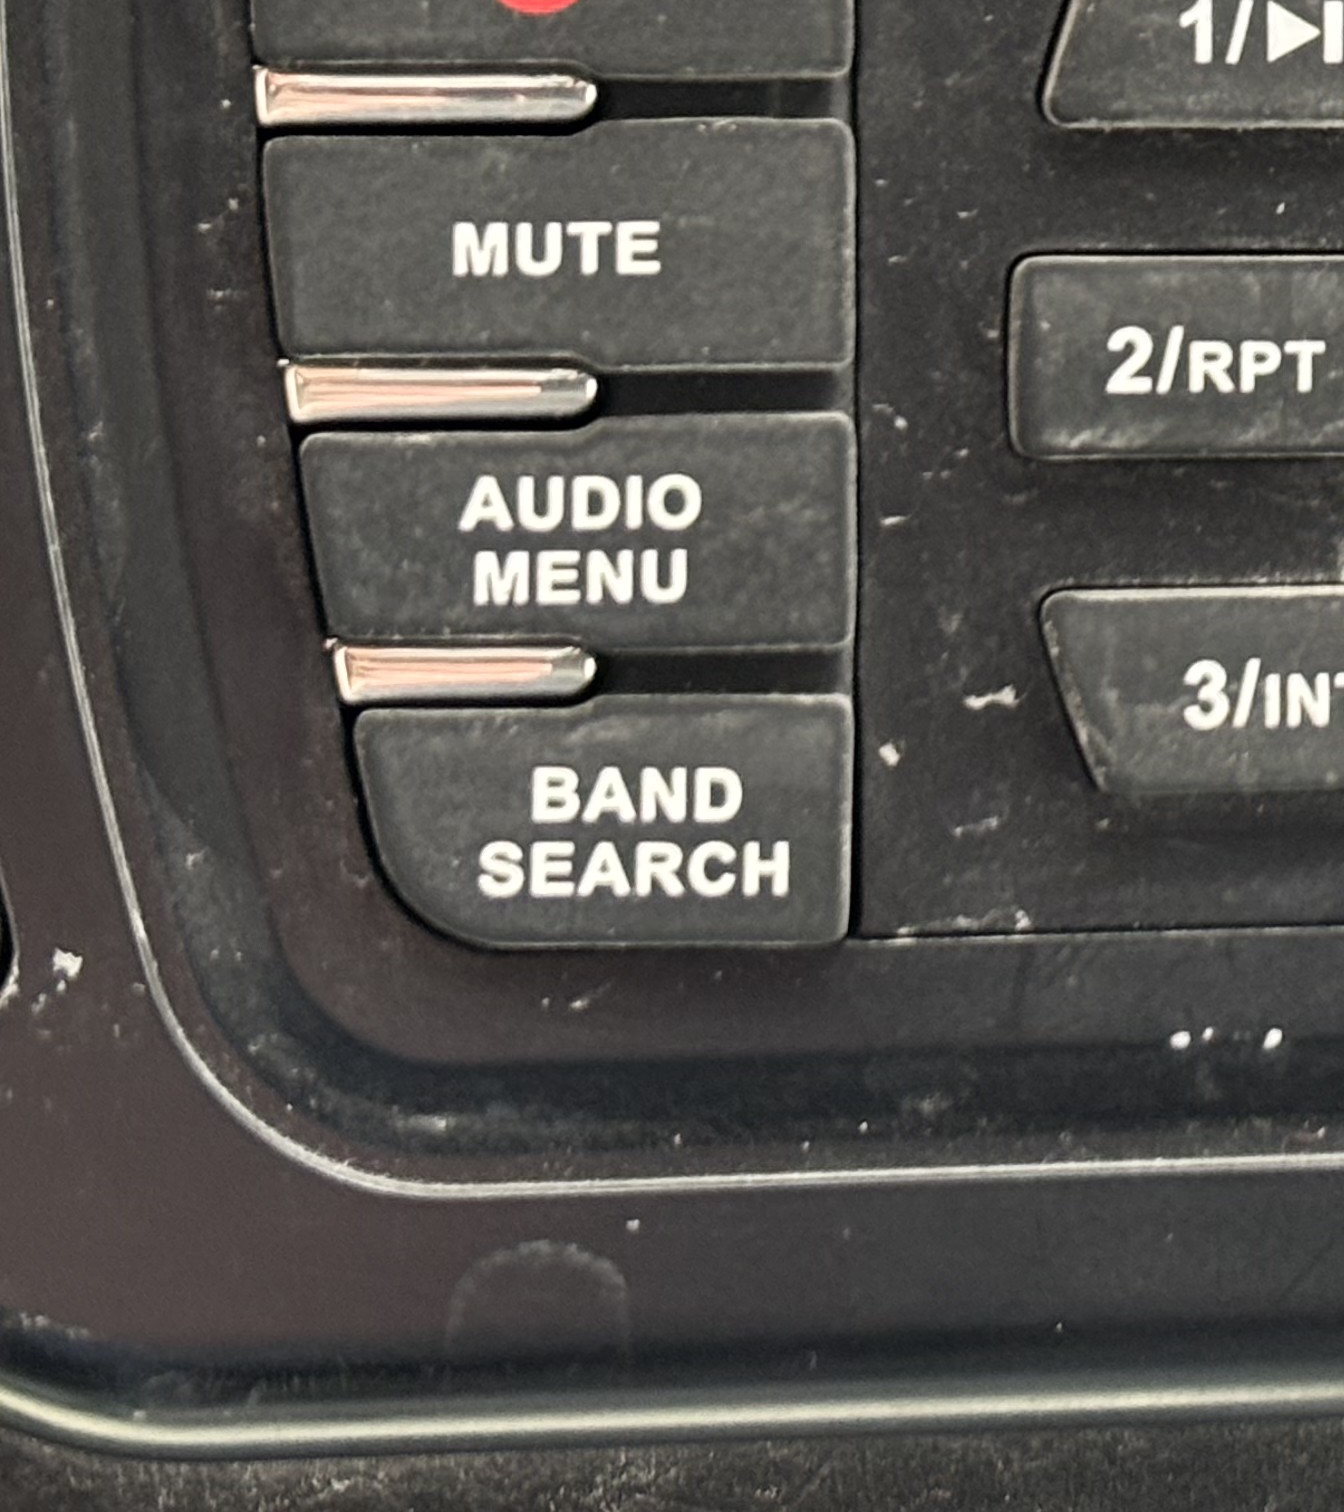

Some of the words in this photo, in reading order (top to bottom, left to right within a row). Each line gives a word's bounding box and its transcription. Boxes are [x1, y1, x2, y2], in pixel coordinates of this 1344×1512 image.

[451, 220, 662, 277] MUTE
[1104, 324, 1327, 396] 2/RPT
[457, 473, 702, 532] AUDIO
[472, 548, 689, 606] MENU
[531, 765, 744, 825] BAND
[476, 840, 791, 899] SEARCH
